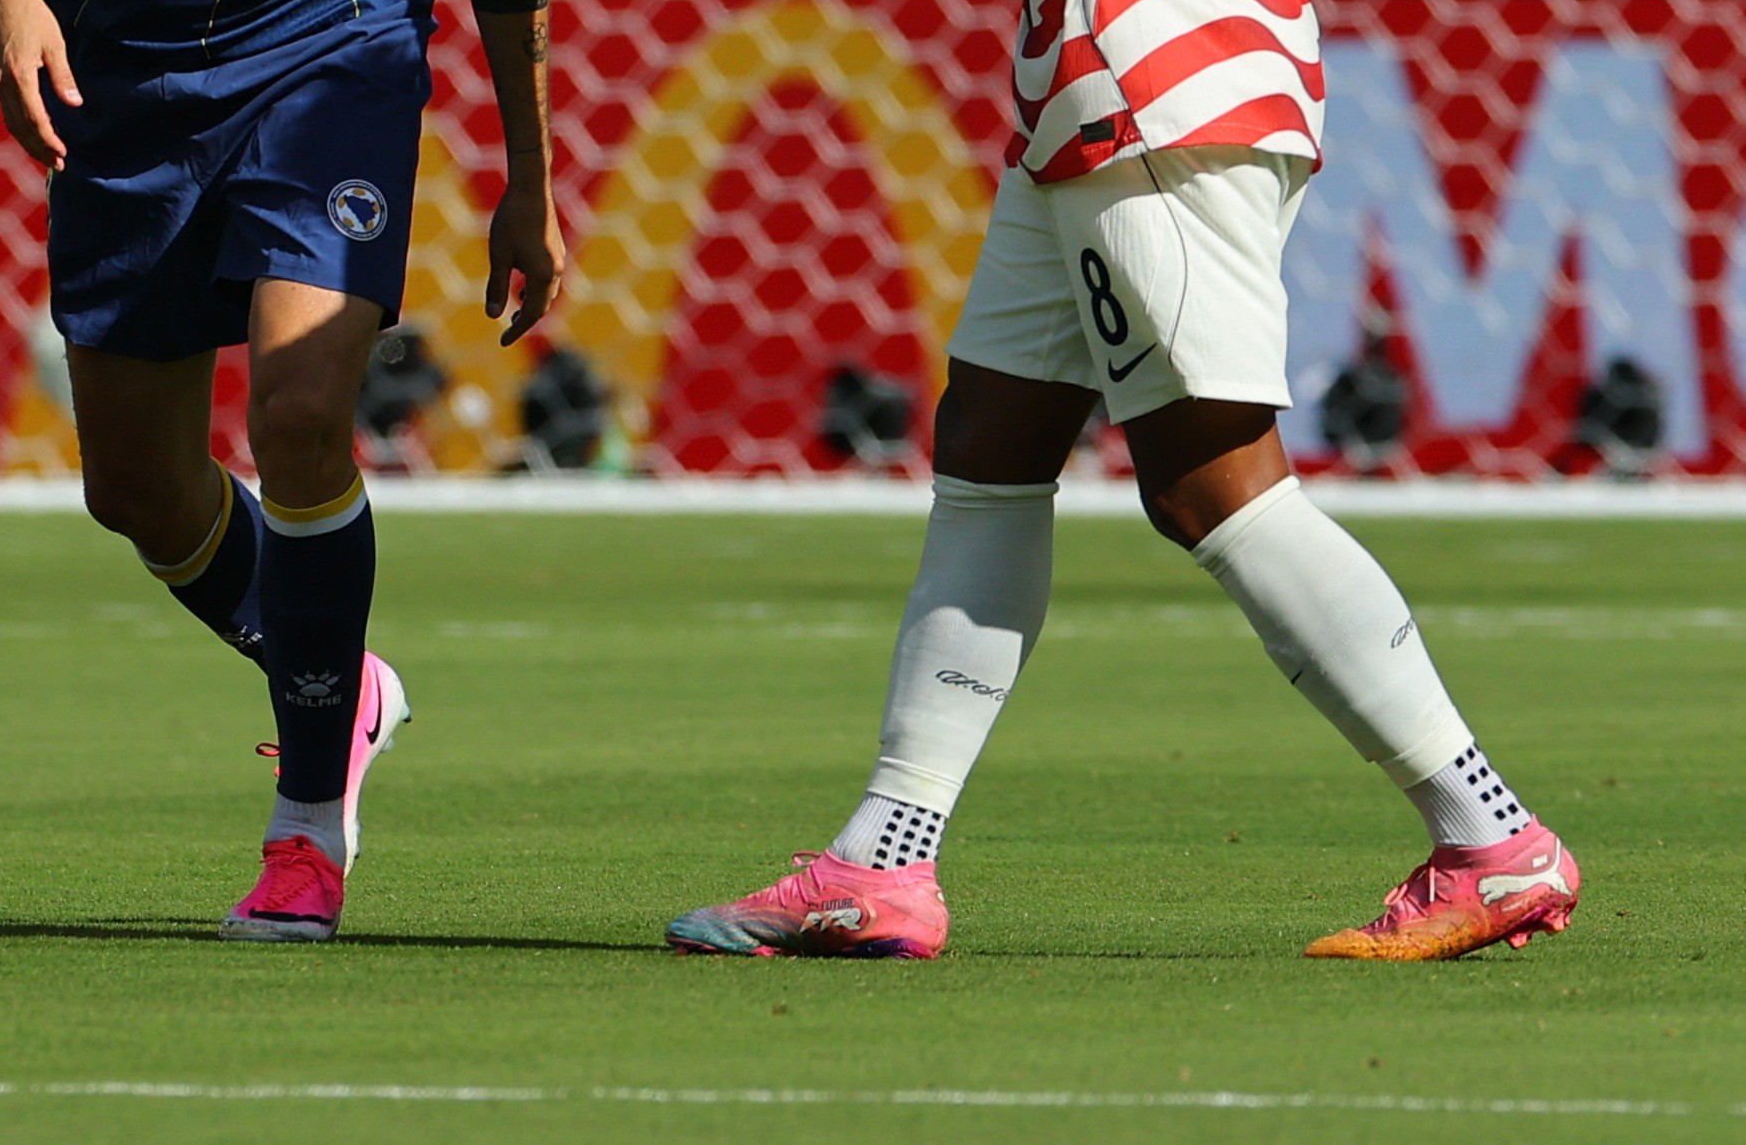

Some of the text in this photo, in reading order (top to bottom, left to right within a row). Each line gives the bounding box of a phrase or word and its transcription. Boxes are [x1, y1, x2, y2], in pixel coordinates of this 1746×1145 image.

[1080, 247, 1129, 346] 8
[285, 691, 342, 708] KELME
[821, 897, 855, 911] FUTURE
